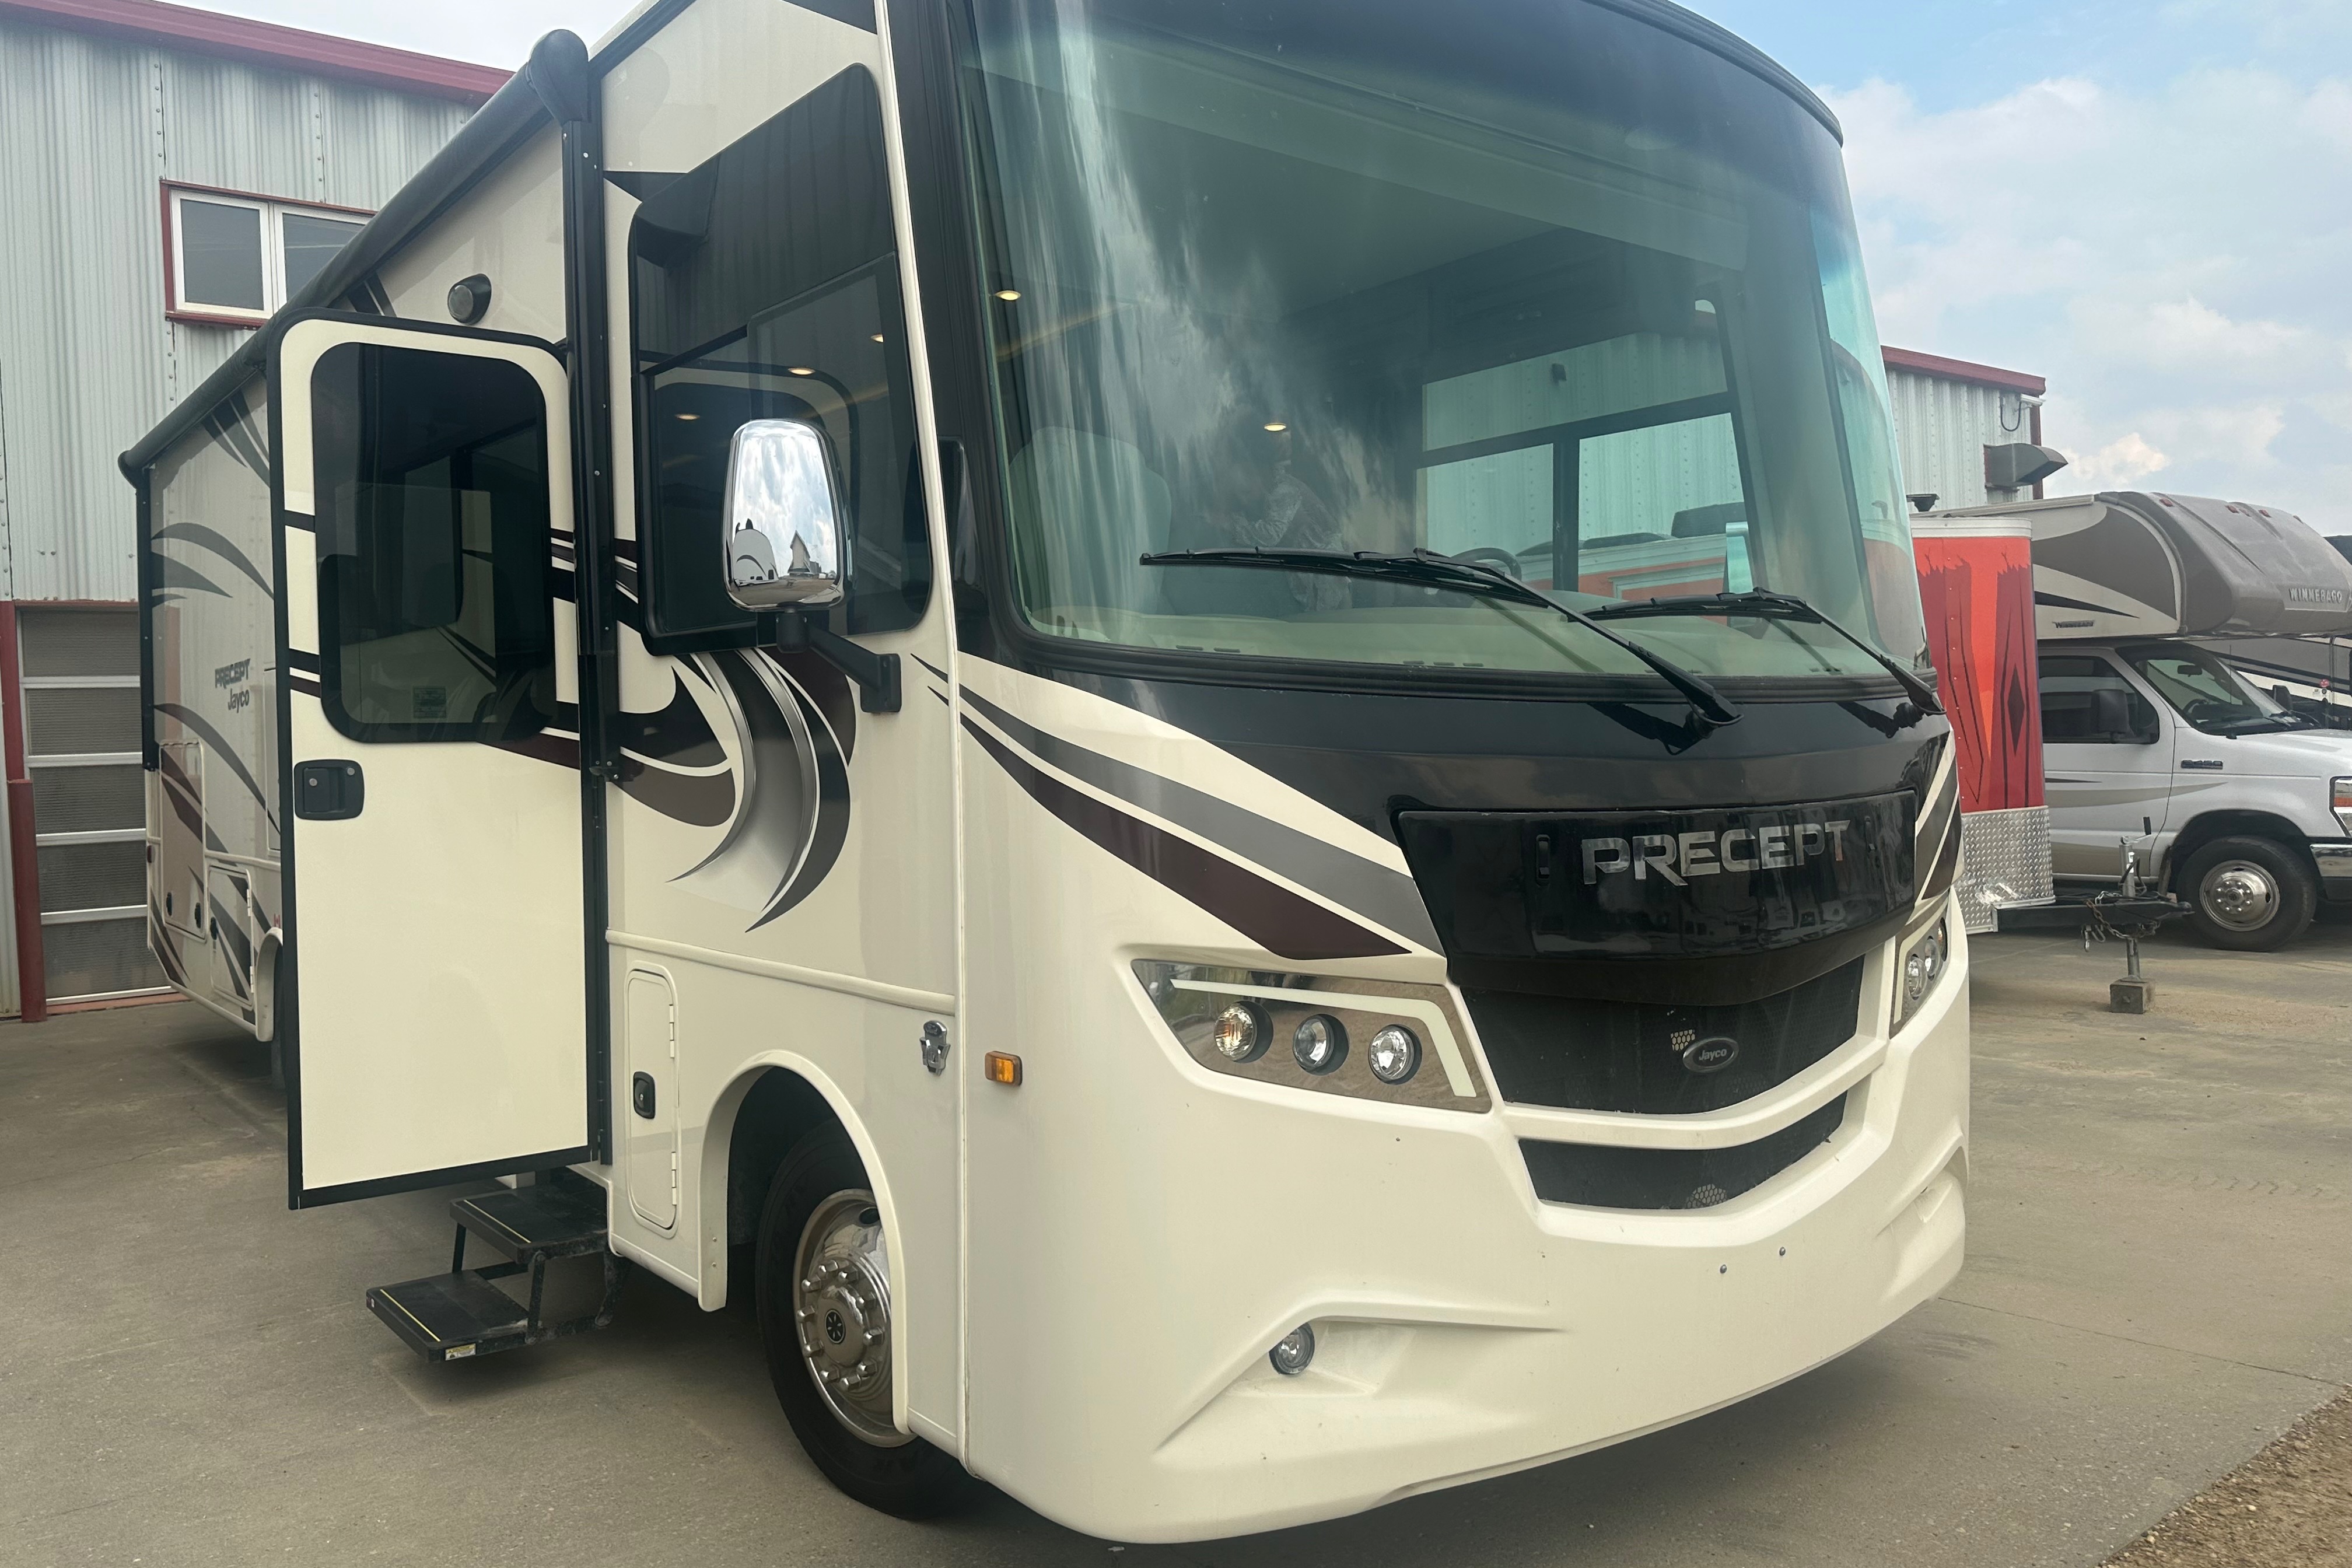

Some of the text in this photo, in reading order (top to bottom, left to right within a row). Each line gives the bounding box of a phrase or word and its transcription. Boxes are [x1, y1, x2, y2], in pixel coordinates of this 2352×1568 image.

[2288, 587, 2343, 603] WINNEBAGO
[228, 688, 250, 713] Jayco
[1581, 820, 1851, 887] PRECEPT
[1698, 1048, 1727, 1061] Jayco
